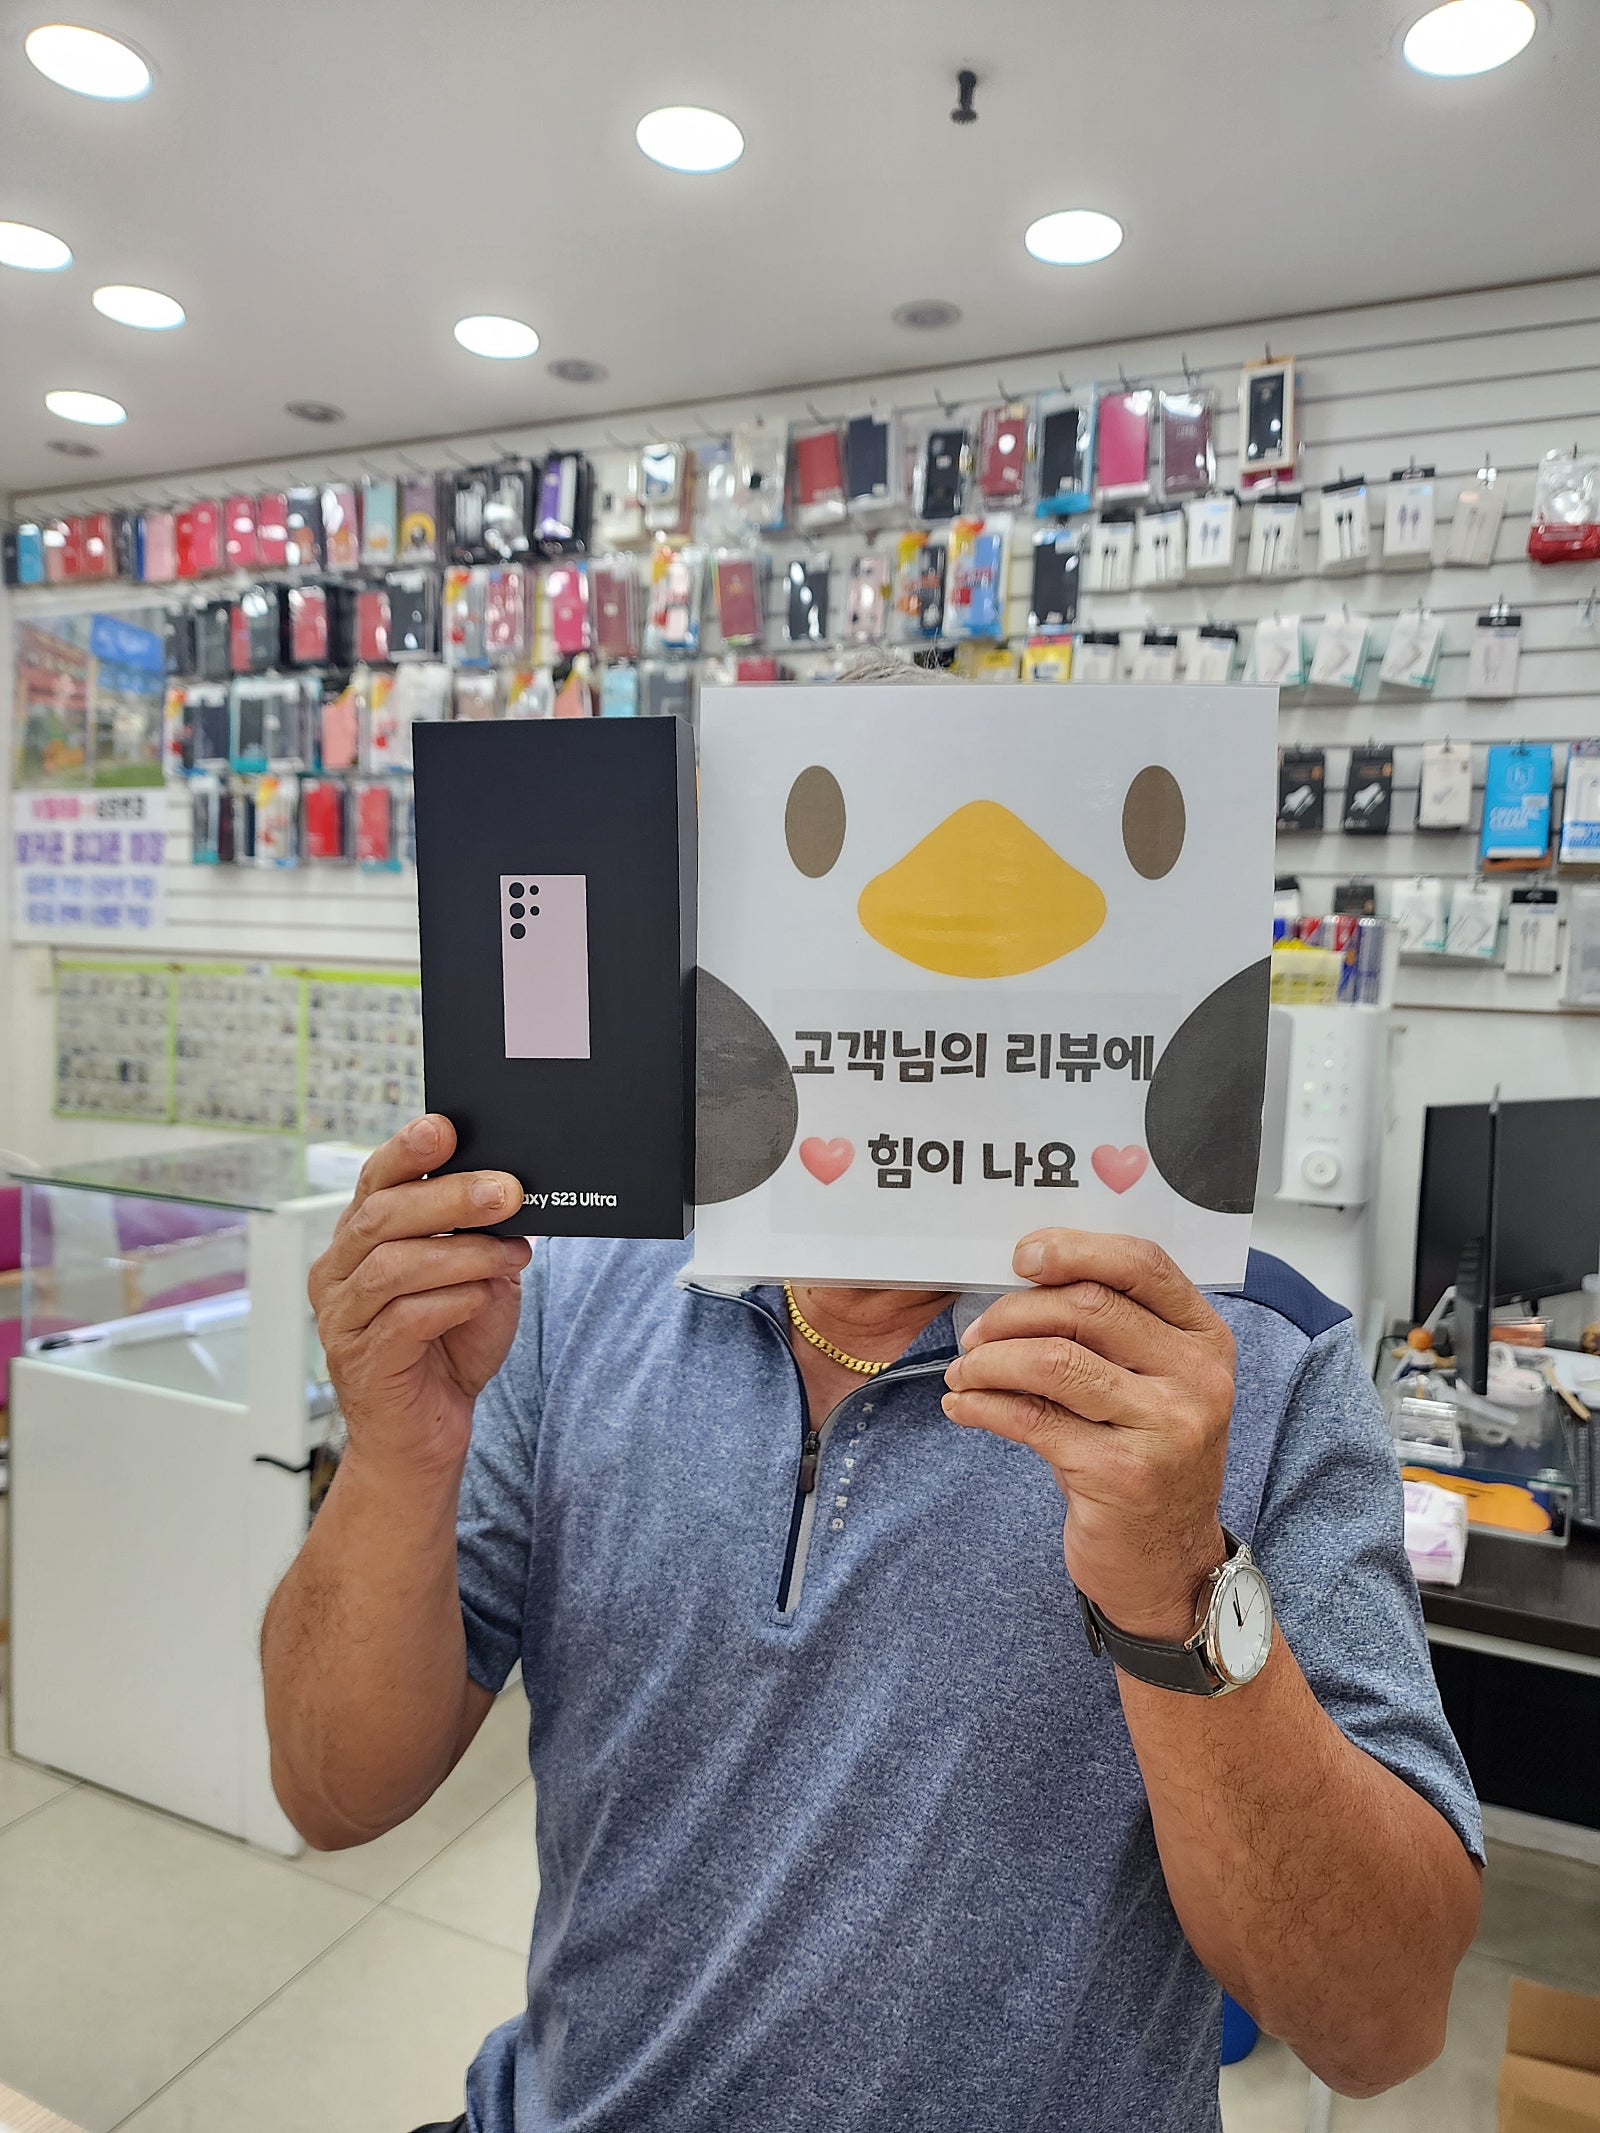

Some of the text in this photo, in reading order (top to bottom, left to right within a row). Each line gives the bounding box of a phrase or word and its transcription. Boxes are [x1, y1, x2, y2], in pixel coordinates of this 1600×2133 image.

[792, 1030, 1155, 1083] 고객님의 리뷰에
[868, 1133, 1079, 1188] 힘이 나요
[522, 1192, 617, 1209] axy S23 Ultra
[831, 1402, 874, 1530] KOLPING
